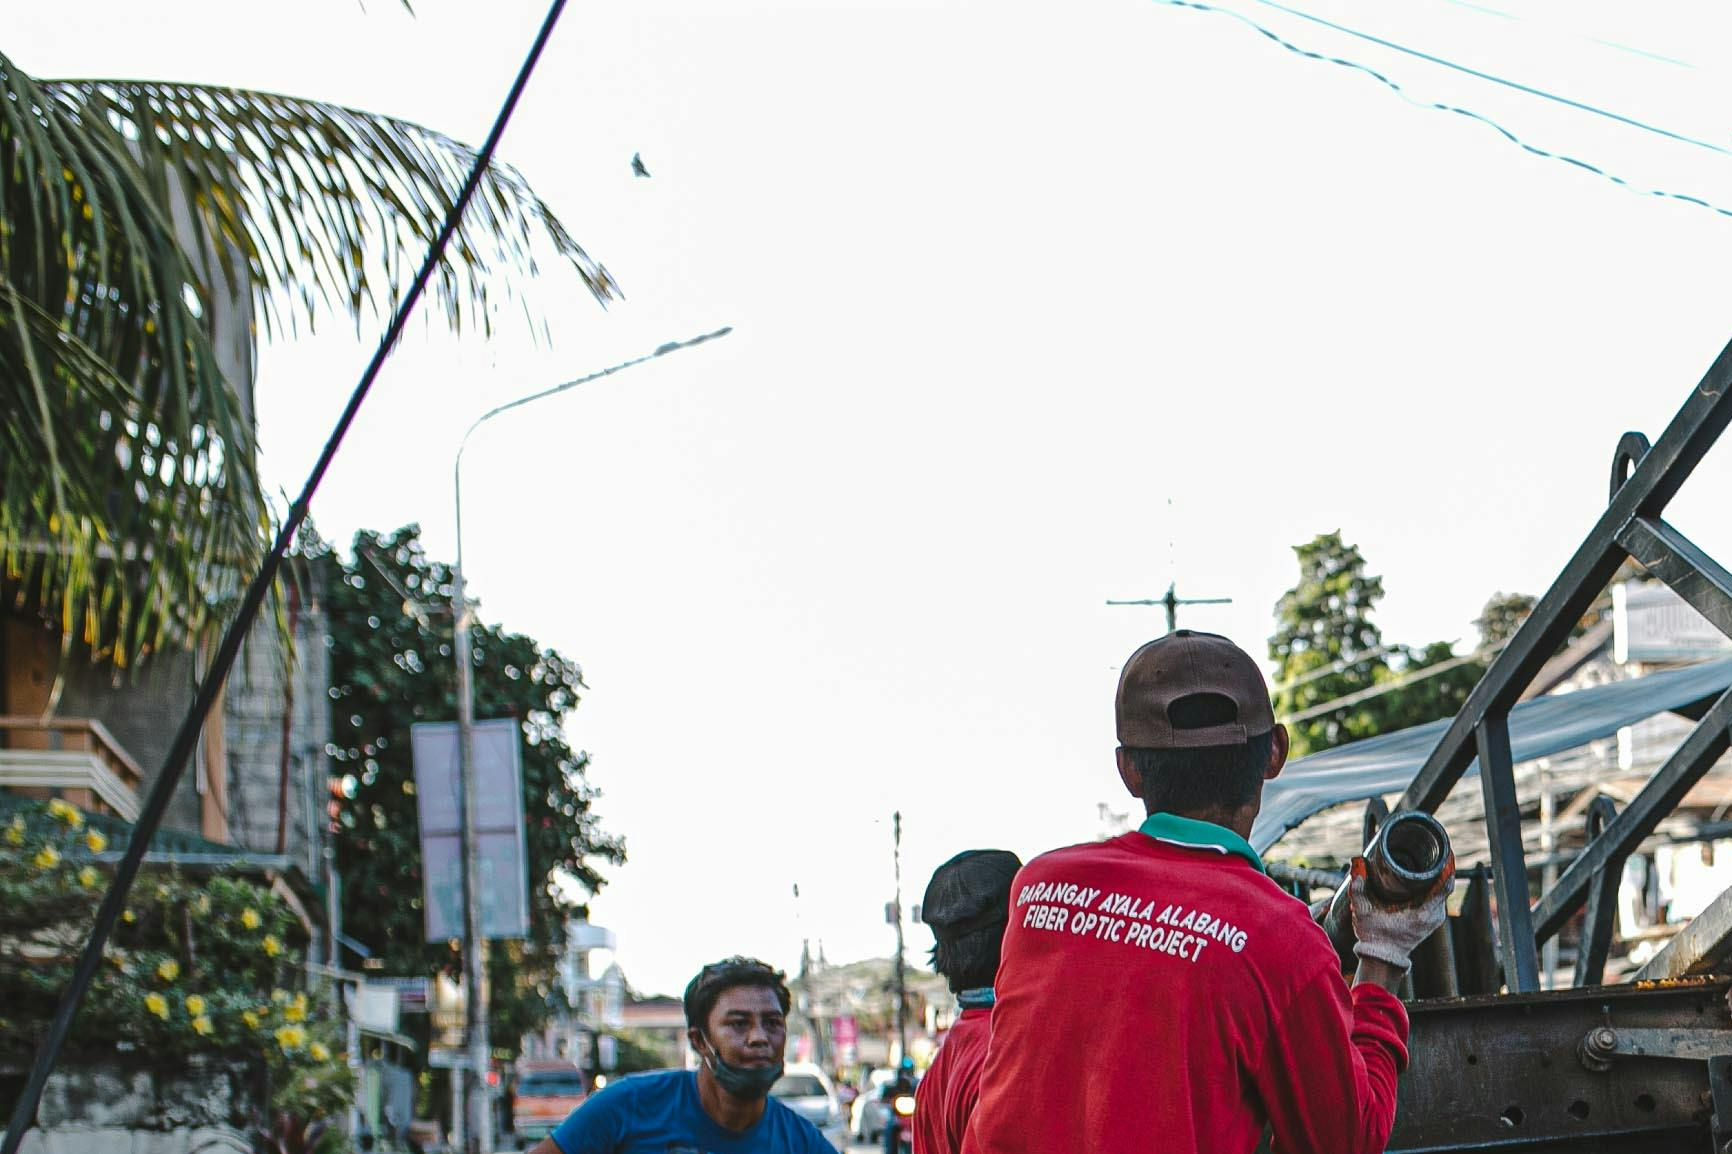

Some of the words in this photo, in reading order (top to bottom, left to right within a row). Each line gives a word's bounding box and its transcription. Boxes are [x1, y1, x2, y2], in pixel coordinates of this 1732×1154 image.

[1016, 881, 1101, 909] BARANGAY
[1098, 892, 1155, 921] AYALA
[1156, 904, 1248, 953] ALABANG
[1023, 904, 1069, 932] FIBER
[1070, 913, 1126, 943] OPTIC
[1123, 921, 1208, 963] PROJECT
